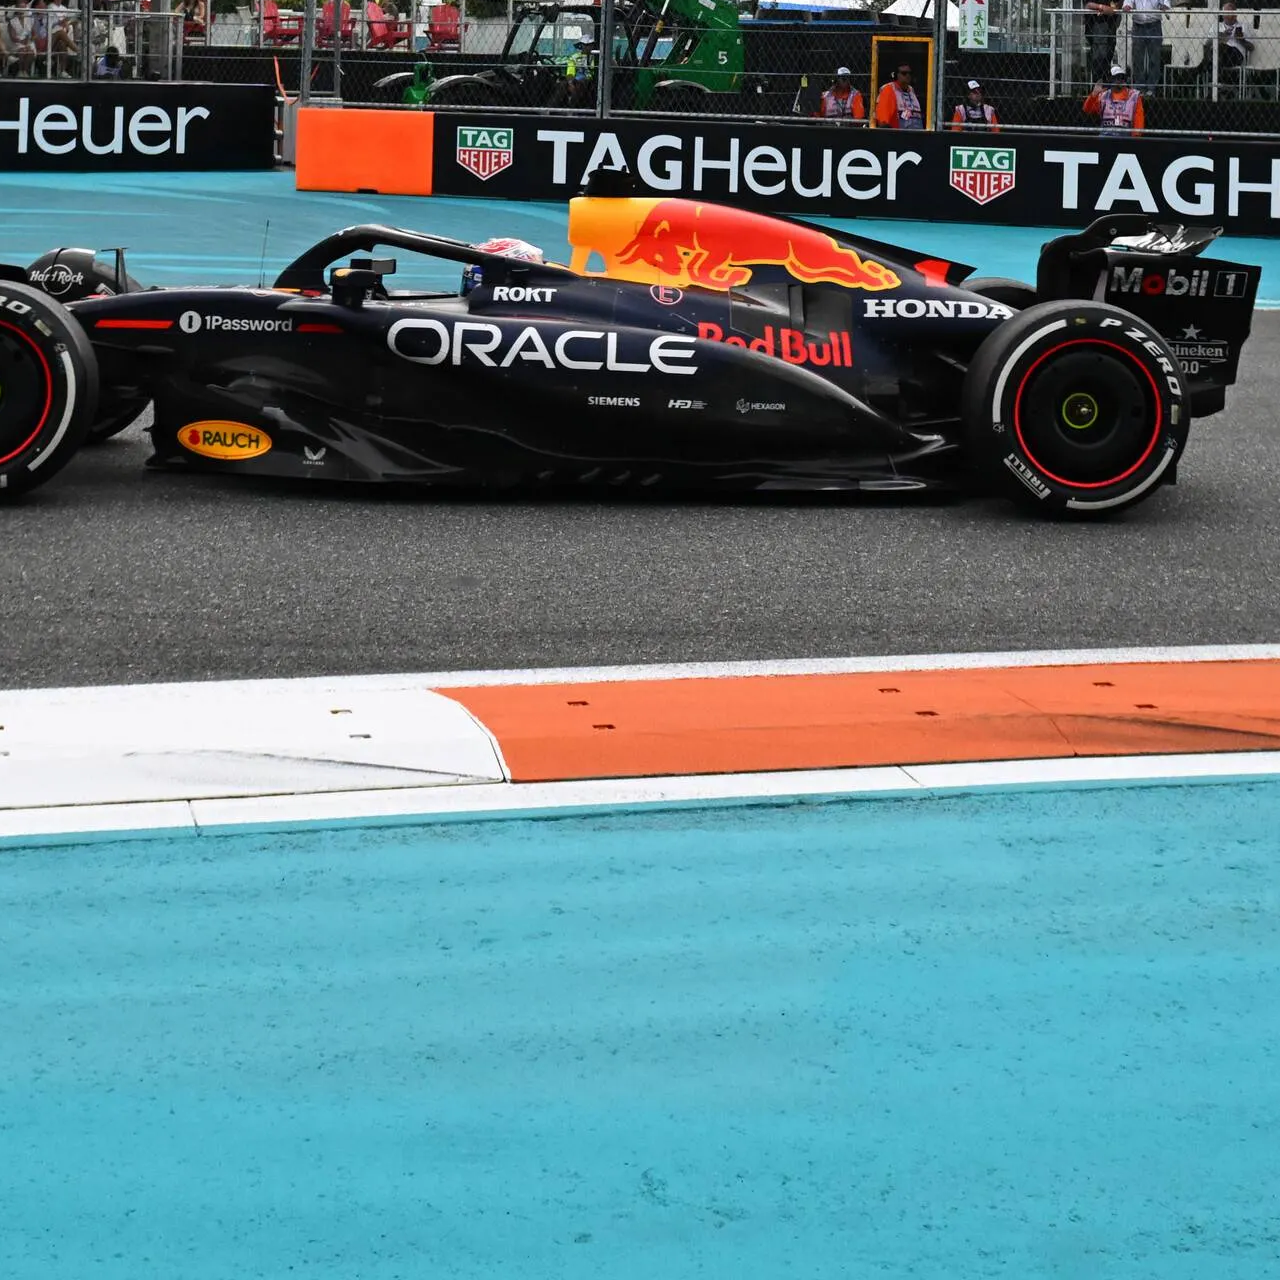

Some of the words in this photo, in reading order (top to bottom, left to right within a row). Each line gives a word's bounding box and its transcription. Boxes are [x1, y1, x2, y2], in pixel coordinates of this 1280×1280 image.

[718, 51, 728, 65] 5
[462, 130, 508, 148] TAG
[460, 150, 510, 178] HEUER
[956, 150, 1010, 169] TAG
[953, 172, 1012, 202] HEUER
[57, 270, 84, 285] Rock
[1110, 266, 1210, 297] Mobil
[492, 286, 558, 303] ROKT
[863, 299, 1015, 319] HONDA
[204, 315, 293, 332] 1Password
[386, 318, 699, 375] ORACLE
[780, 327, 853, 368] Bull
[1169, 344, 1224, 357] ineken
[1099, 317, 1123, 327] P
[1124, 327, 1182, 396] ZERO
[587, 395, 641, 407] SIEMENS
[750, 402, 786, 411] HEXAGON
[202, 430, 260, 449] RAUCH
[1003, 453, 1052, 500] PIRELLI
